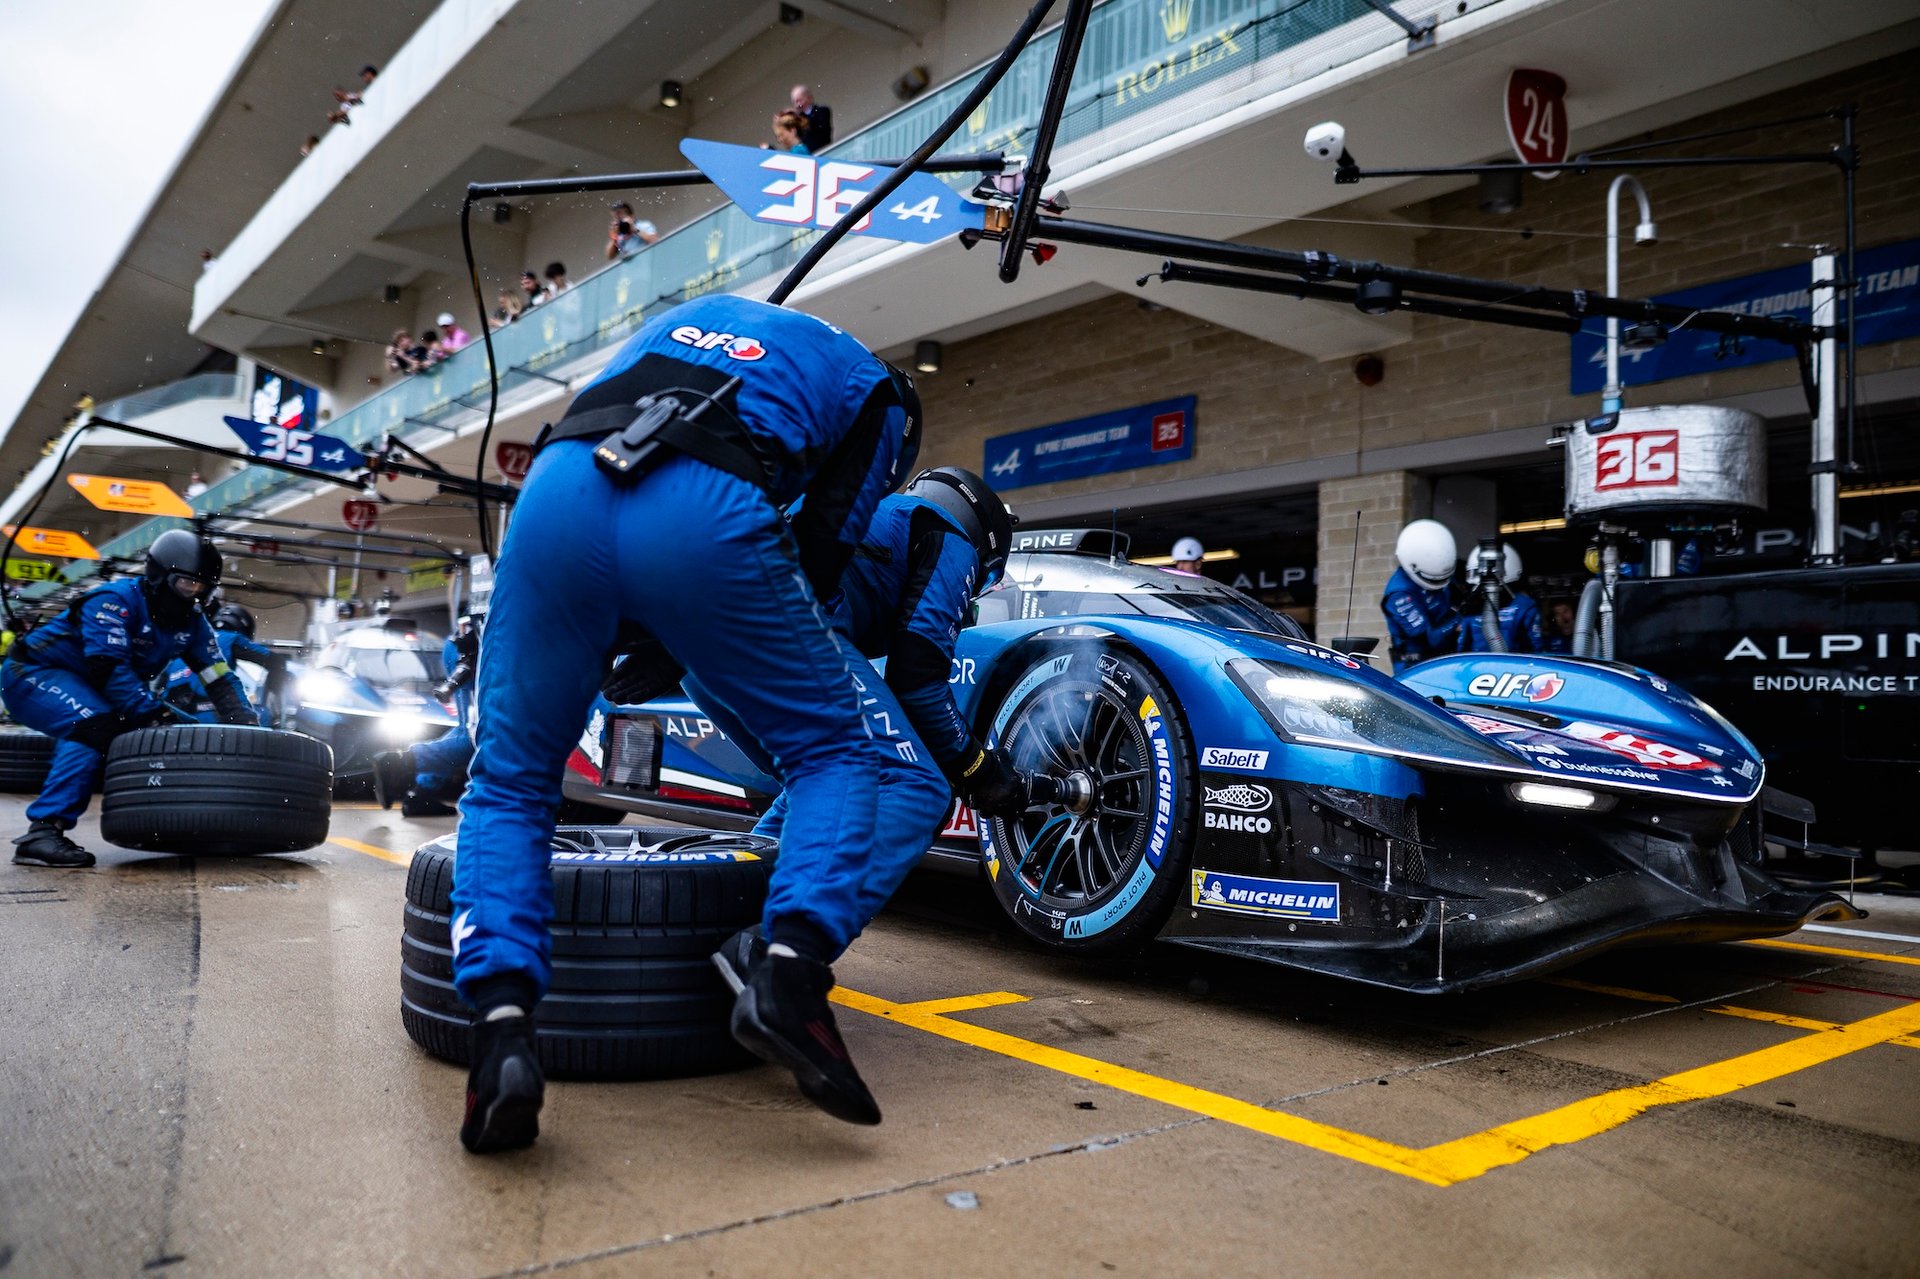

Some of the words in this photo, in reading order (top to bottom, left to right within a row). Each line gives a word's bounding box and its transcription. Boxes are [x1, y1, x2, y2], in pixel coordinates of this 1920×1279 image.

[1115, 23, 1241, 107] ROLEX
[1523, 88, 1555, 158] 24
[756, 154, 875, 232] 36
[1866, 265, 1920, 295] TEAM
[670, 325, 735, 351] elf
[1157, 421, 1179, 442] 35
[260, 426, 315, 466] 35
[1599, 435, 1677, 487] 36
[1053, 658, 1066, 673] W
[1468, 672, 1531, 698] elf
[1753, 676, 1897, 692] ENDURANCE
[25, 676, 93, 719] ALPINE
[1208, 749, 1261, 767] Sabelt
[1557, 759, 1661, 781] businessolver
[1150, 738, 1172, 857] MICHELIN
[1205, 812, 1272, 834] BAHCO
[1129, 871, 1147, 900] PILOT
[1228, 888, 1334, 909] MICHELIN
[1103, 898, 1128, 921] SPORT
[1069, 920, 1082, 935] W
